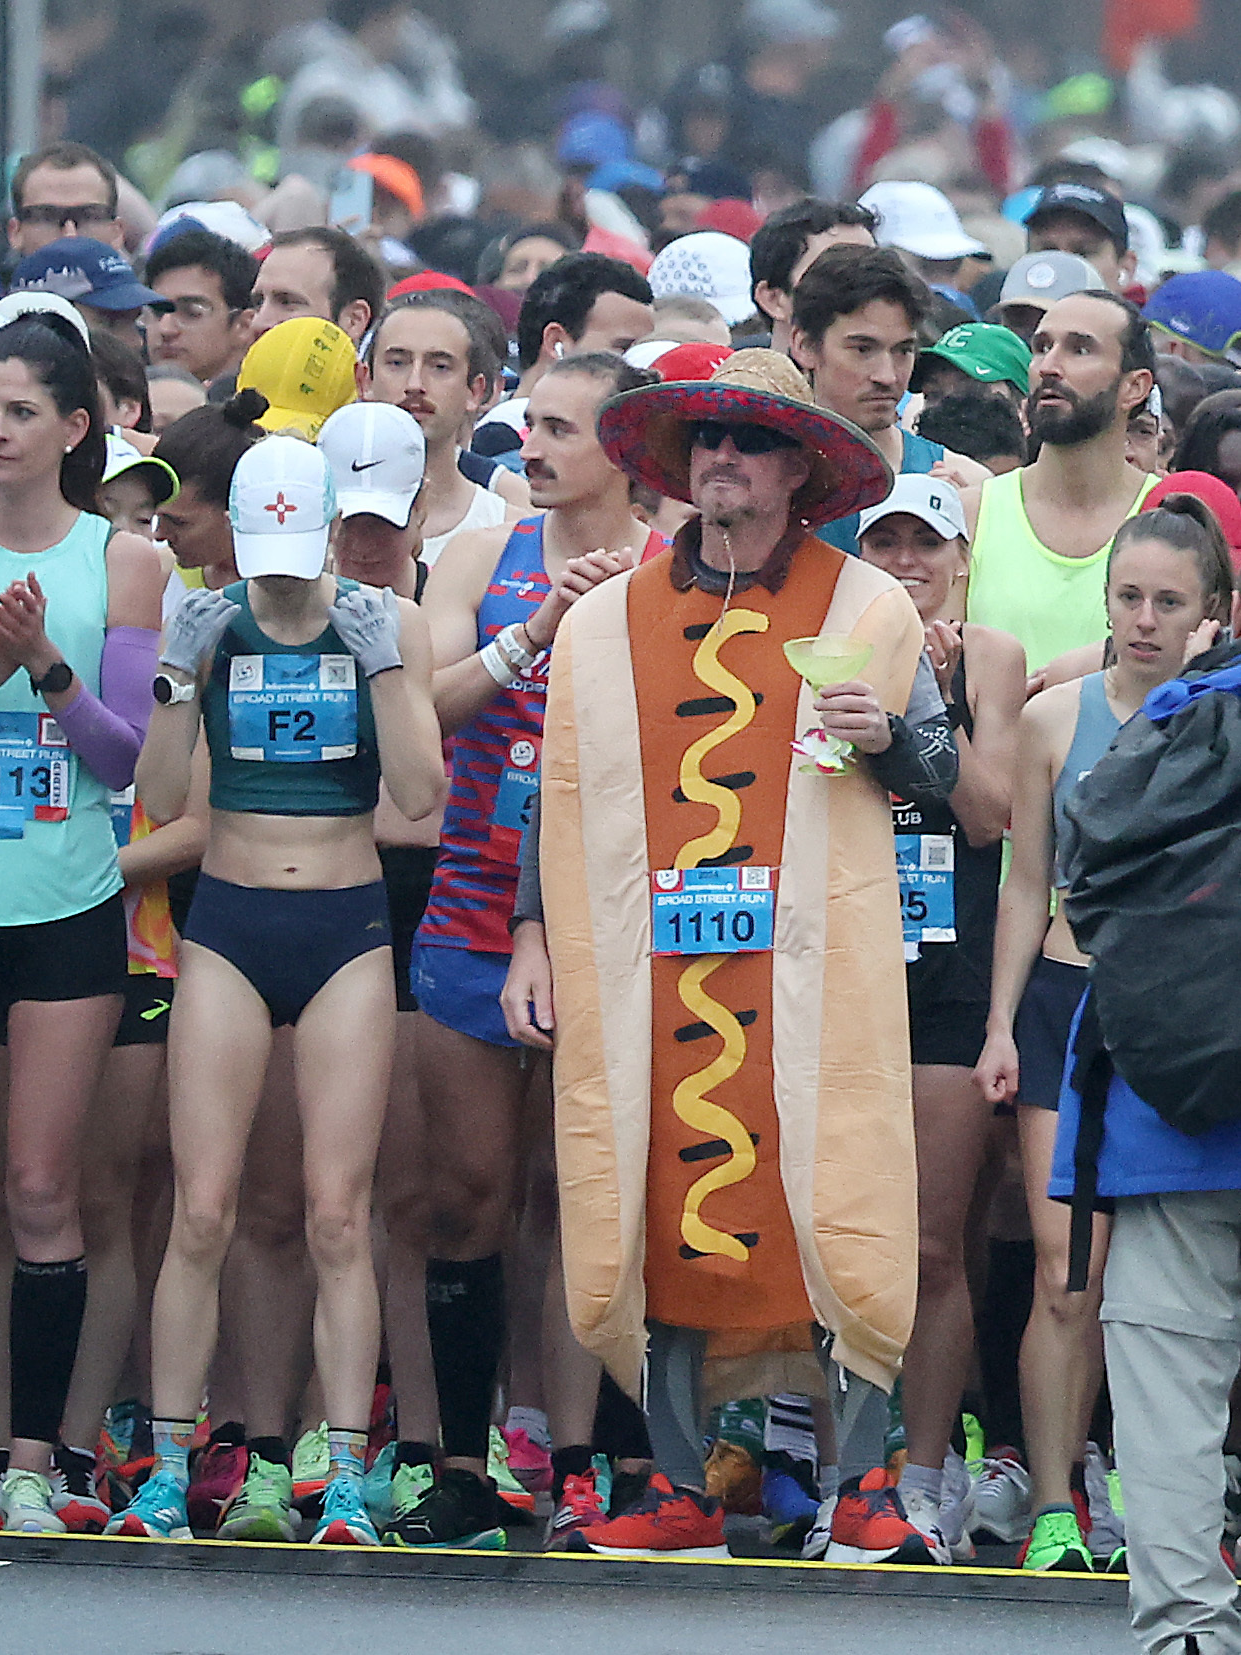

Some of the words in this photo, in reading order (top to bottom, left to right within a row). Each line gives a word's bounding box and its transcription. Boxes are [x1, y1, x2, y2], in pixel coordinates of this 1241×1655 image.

[232, 692, 275, 704] BROAD
[276, 692, 319, 704] STREET
[321, 692, 349, 703] RUN
[268, 710, 316, 741] F2
[38, 749, 66, 760] RUN
[922, 873, 947, 885] RUN
[657, 894, 694, 906] BROAD
[694, 893, 737, 905] STREET
[738, 893, 767, 904] RUN
[668, 910, 755, 943] 1110
